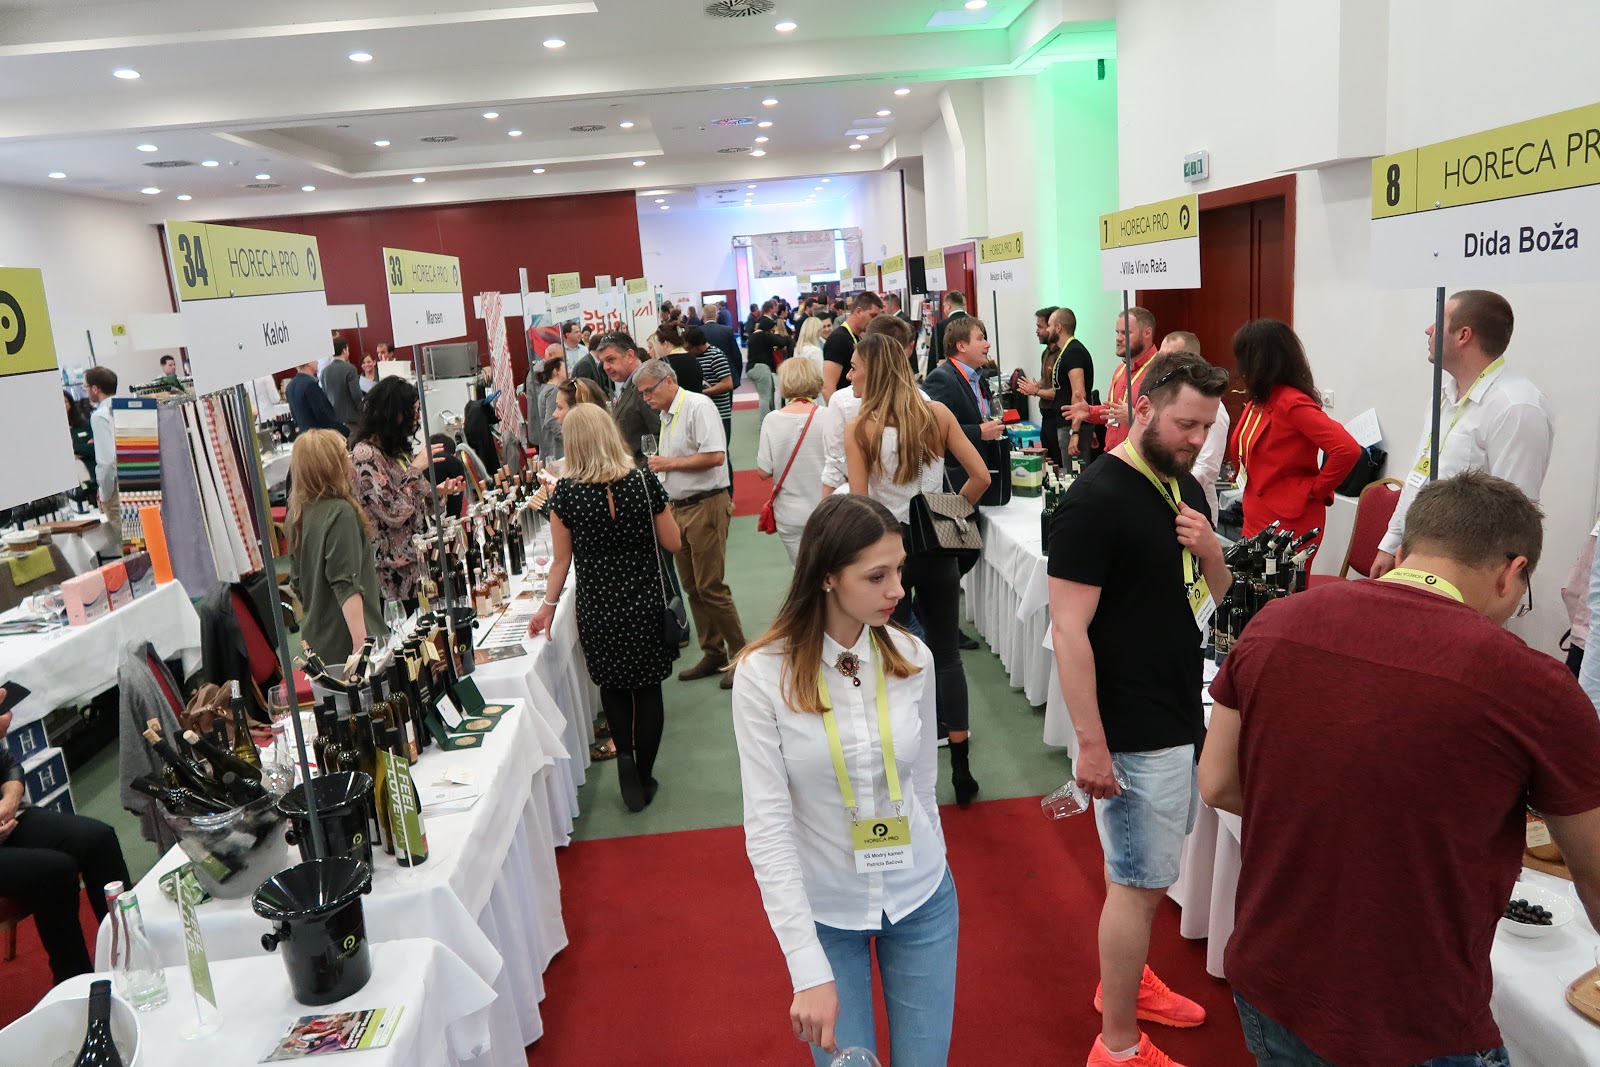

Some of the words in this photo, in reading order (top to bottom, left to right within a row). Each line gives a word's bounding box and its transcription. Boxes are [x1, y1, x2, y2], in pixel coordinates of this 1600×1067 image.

[1444, 138, 1557, 190] HORECA
[1566, 127, 1600, 167] PR
[1386, 163, 1400, 207] 8
[1120, 216, 1152, 237] HORECA
[1152, 212, 1169, 232] PRO
[1464, 230, 1511, 258] Dida
[1518, 221, 1579, 253] Boža
[178, 233, 209, 288] 34
[227, 247, 280, 278] HORECA
[279, 250, 300, 277] PRO
[389, 255, 403, 287] 33
[412, 264, 437, 283] HORECA
[1121, 261, 1134, 275] Villa
[1135, 260, 1149, 274] Vino
[1150, 257, 1167, 273] Rača
[262, 320, 290, 347] Kaloh
[37, 764, 57, 792] H
[395, 760, 407, 771] I
[397, 773, 415, 815] FEEL
[187, 904, 204, 955] FEEL
